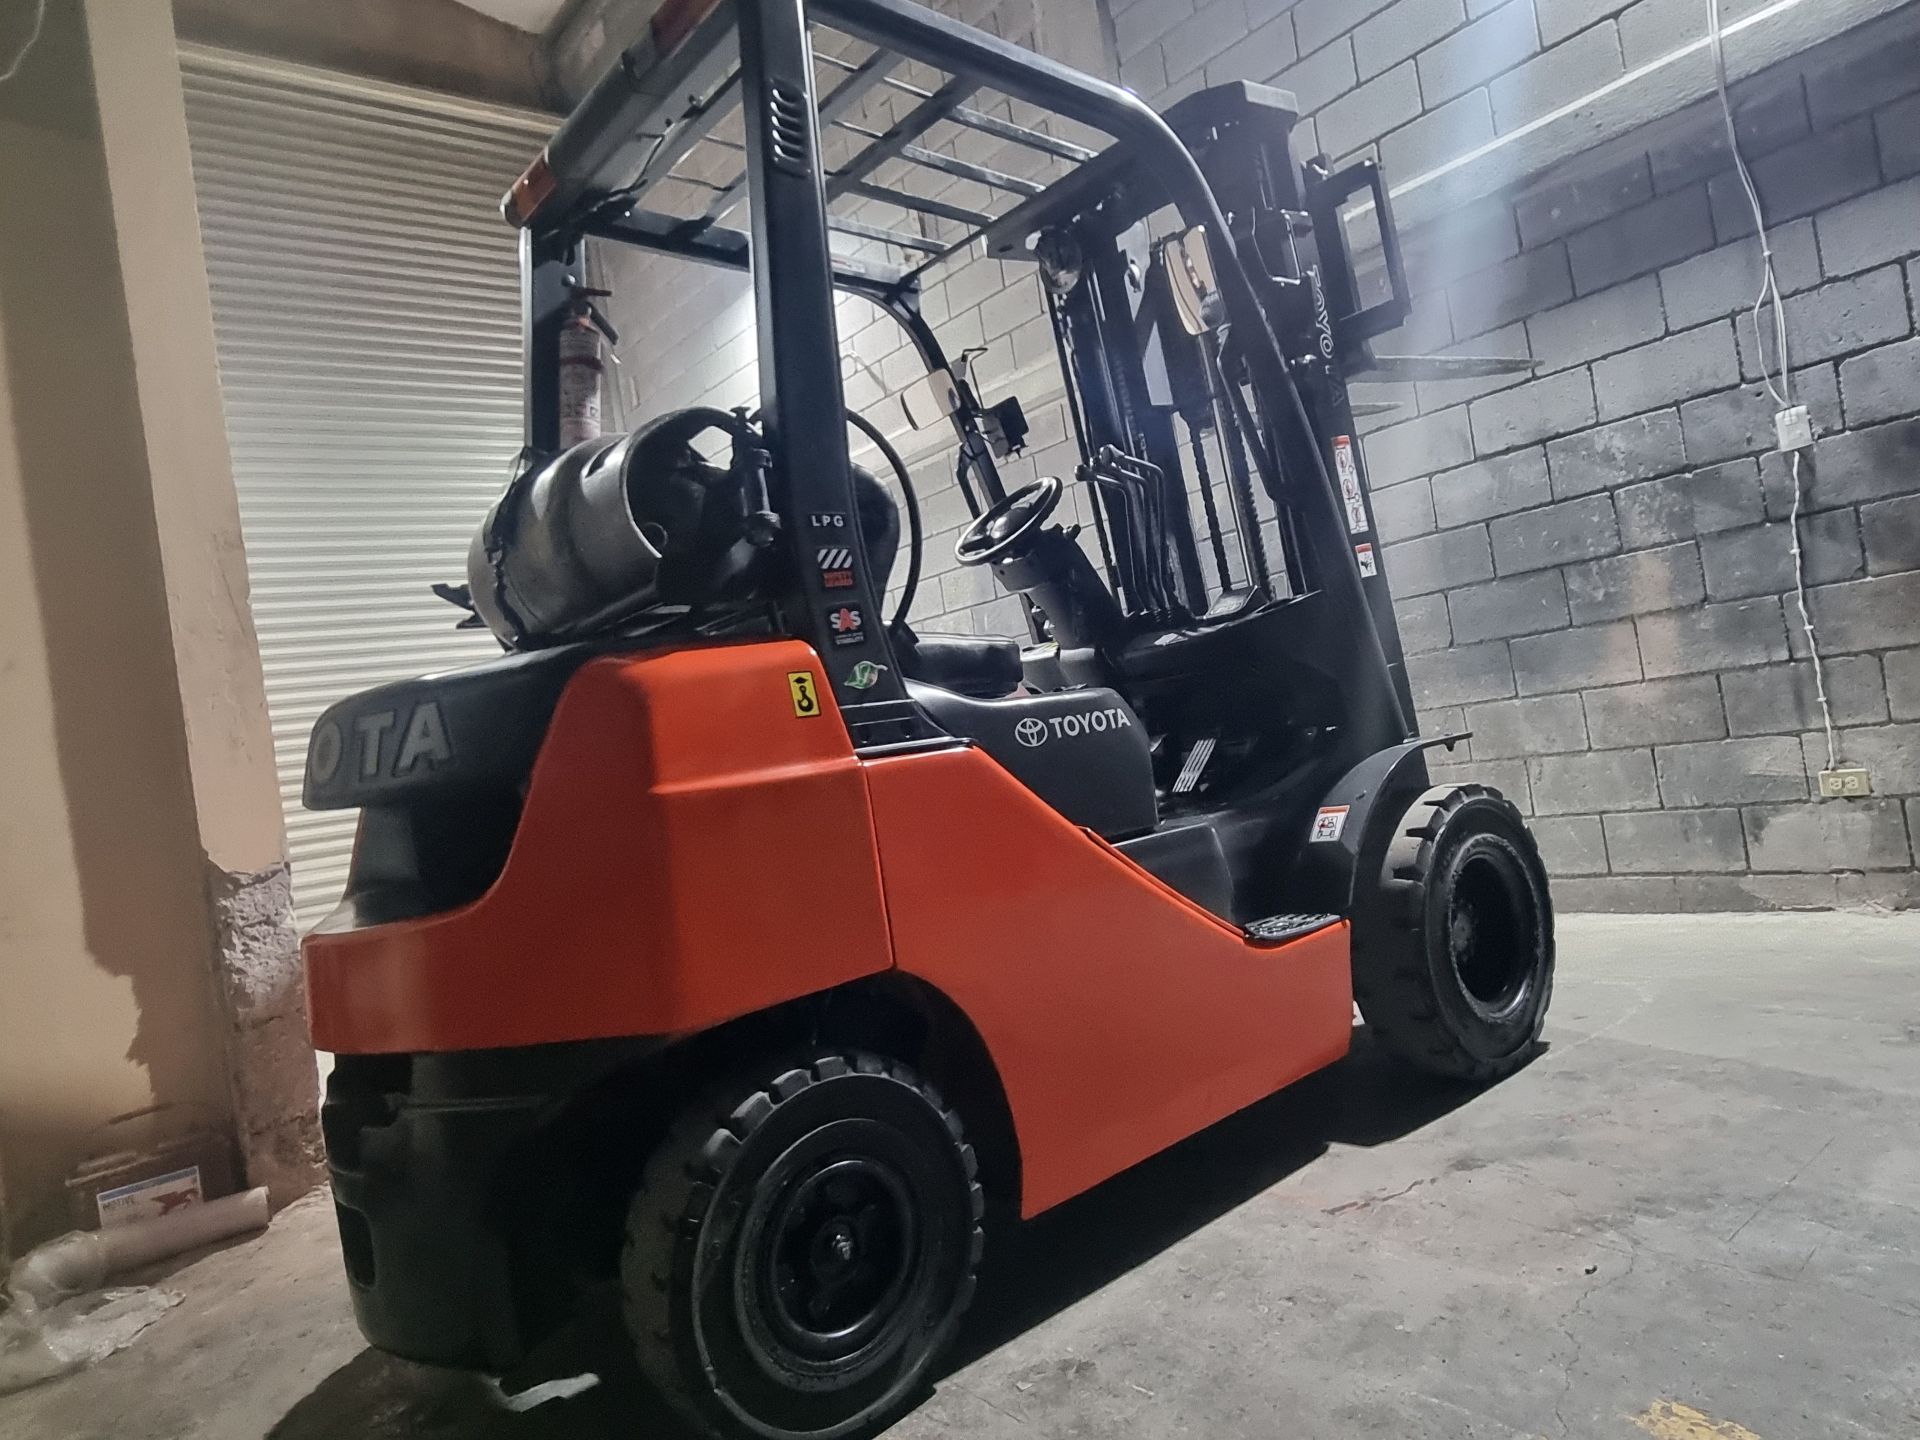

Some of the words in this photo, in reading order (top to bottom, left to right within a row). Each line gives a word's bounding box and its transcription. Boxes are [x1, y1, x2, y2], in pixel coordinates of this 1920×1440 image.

[812, 515, 844, 527] LPG
[830, 608, 861, 632] SAS
[1048, 708, 1131, 739] TOYOTA
